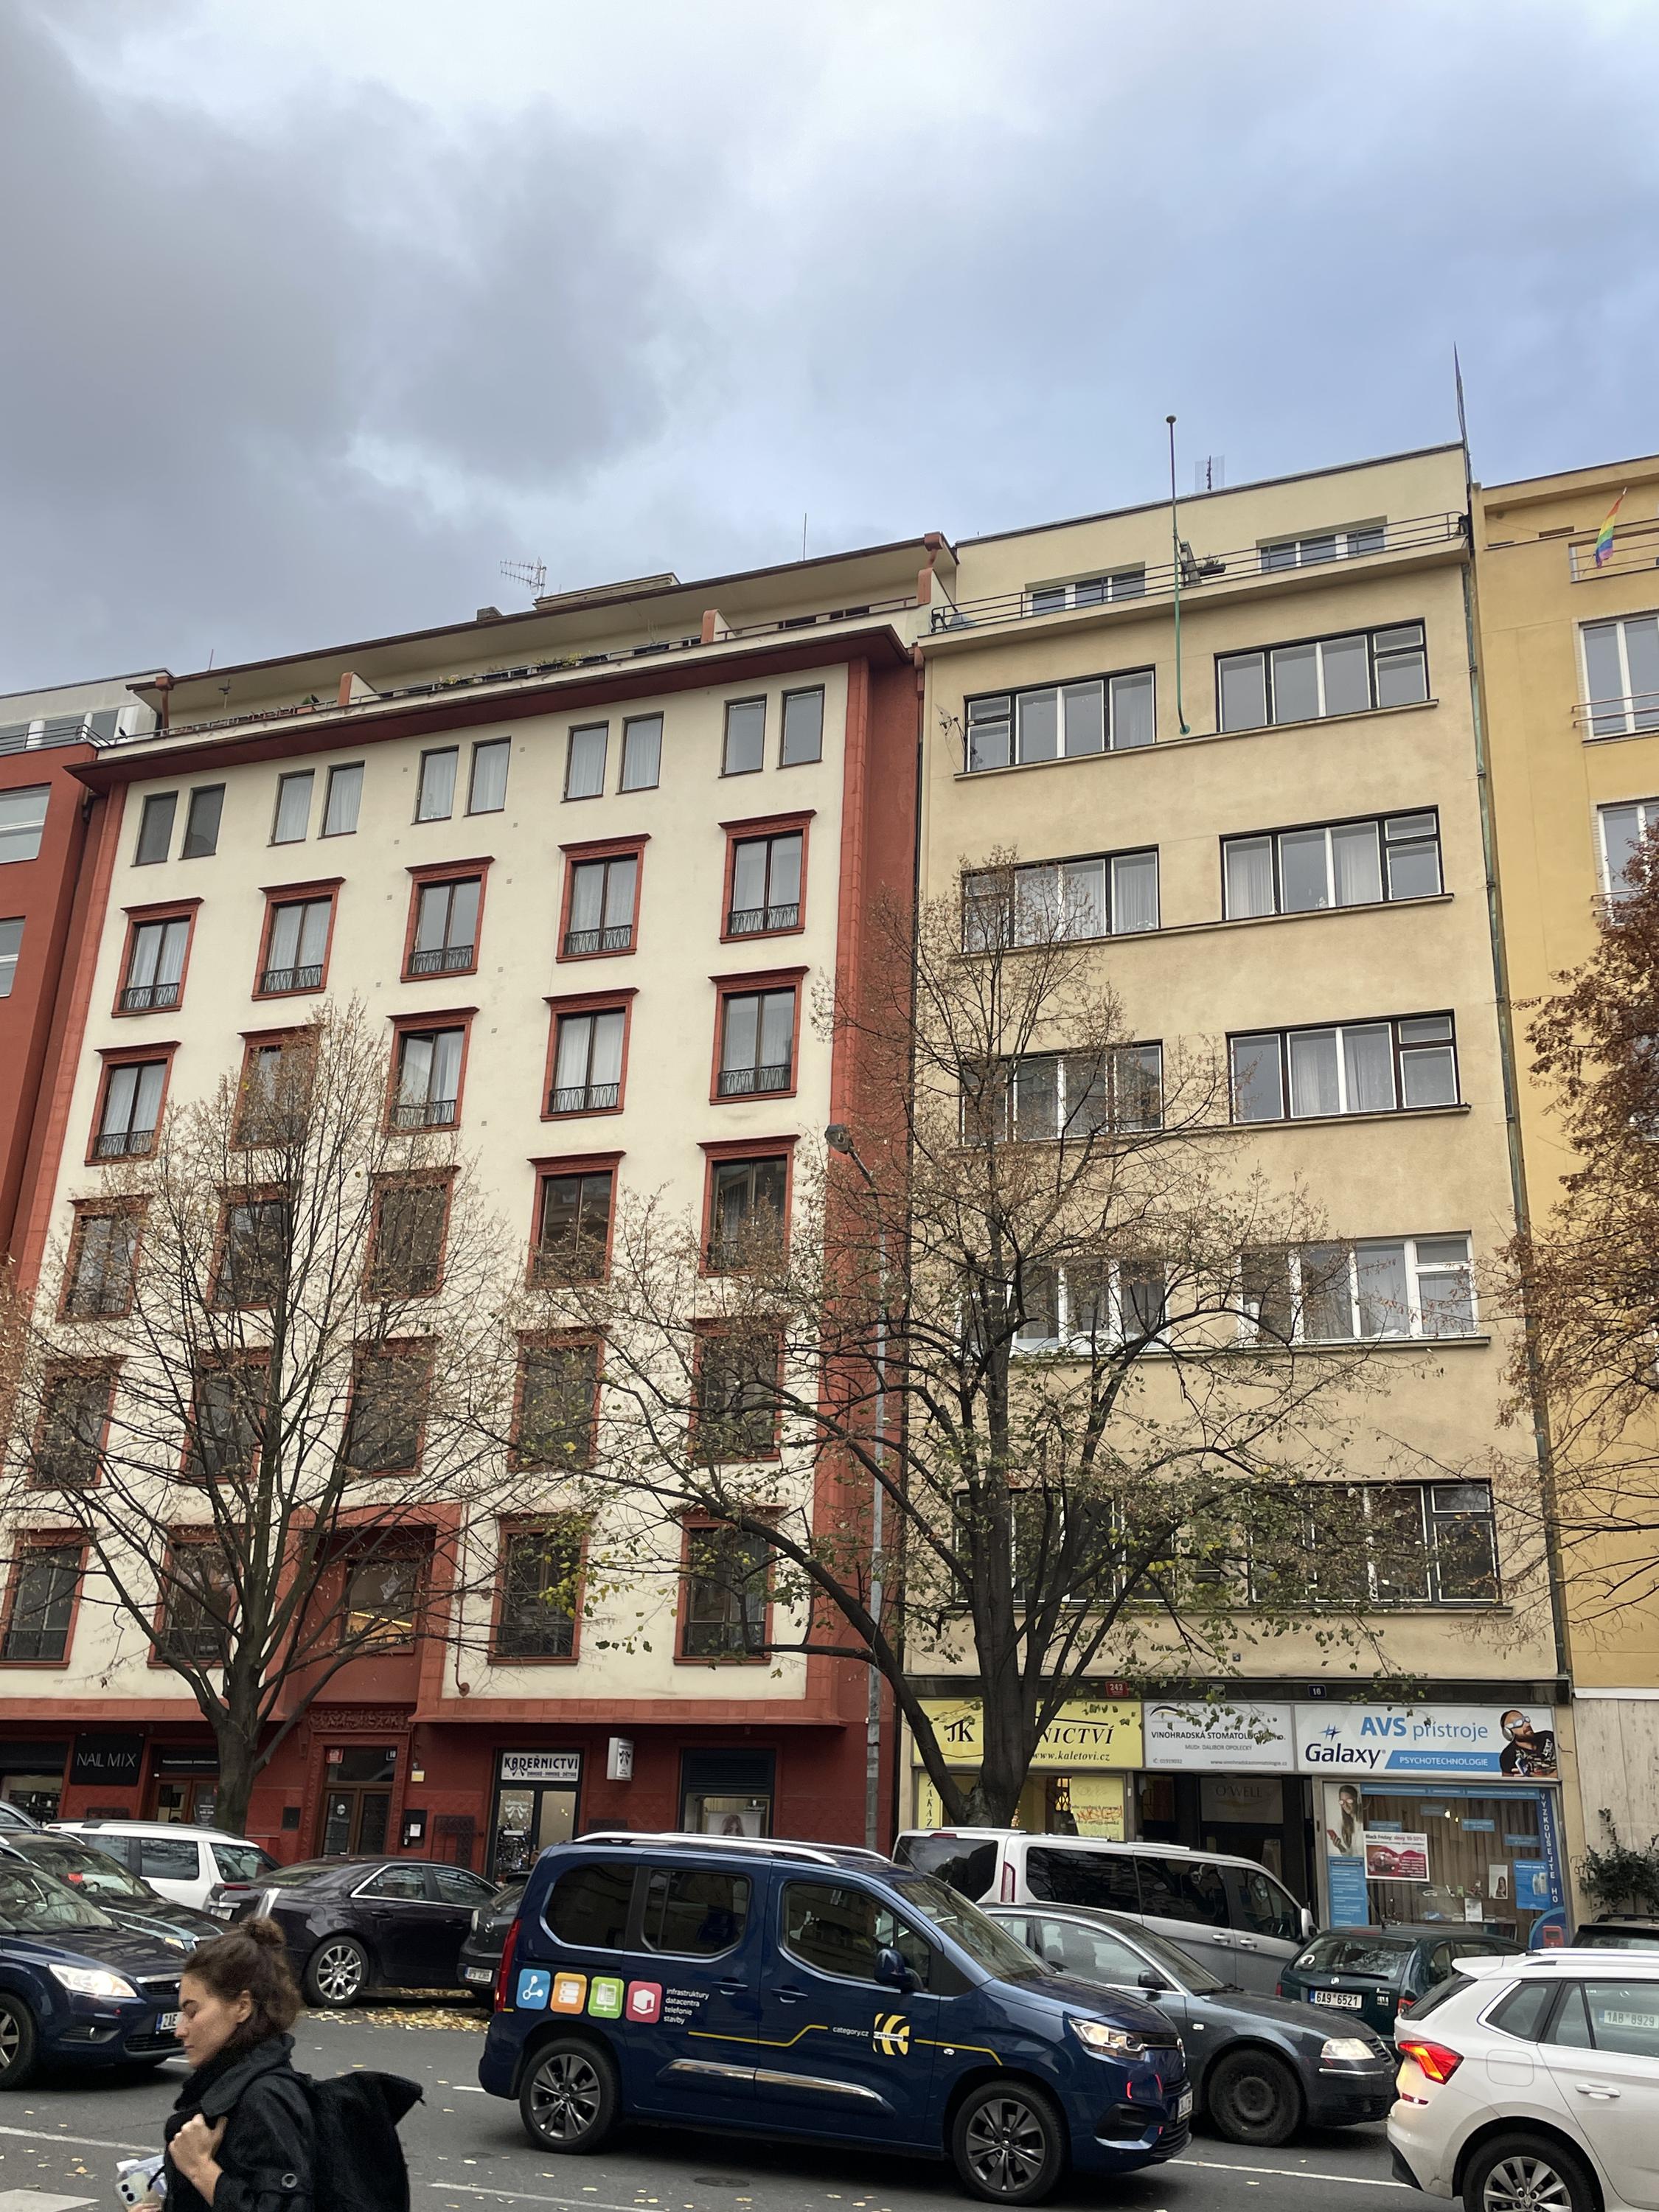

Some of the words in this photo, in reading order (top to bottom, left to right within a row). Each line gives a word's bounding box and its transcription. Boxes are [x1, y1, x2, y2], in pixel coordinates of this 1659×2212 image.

[1109, 1683, 1124, 1691] 242
[1360, 1717, 1407, 1736] AVS
[1151, 1731, 1206, 1739] VINOHRADSKÁ
[77, 1753, 105, 1767] NAIL
[107, 1753, 136, 1768] MIX
[504, 1755, 579, 1771] KADEŘNICTVÍ
[1399, 1756, 1488, 1767] PSYCHOTECHNOLOGIE
[1551, 1888, 1559, 1903] HO
[667, 1988, 709, 2000] infrastruktury
[1316, 1992, 1332, 2003] 6A9
[1337, 1994, 1358, 2006] 6521
[666, 1997, 700, 2007] datacentra
[664, 2006, 692, 2016] telefonie
[664, 2016, 685, 2025] stavby
[1607, 2011, 1624, 2024] 1AB
[1631, 2014, 1655, 2027] 8929
[832, 2026, 869, 2037] category.cz
